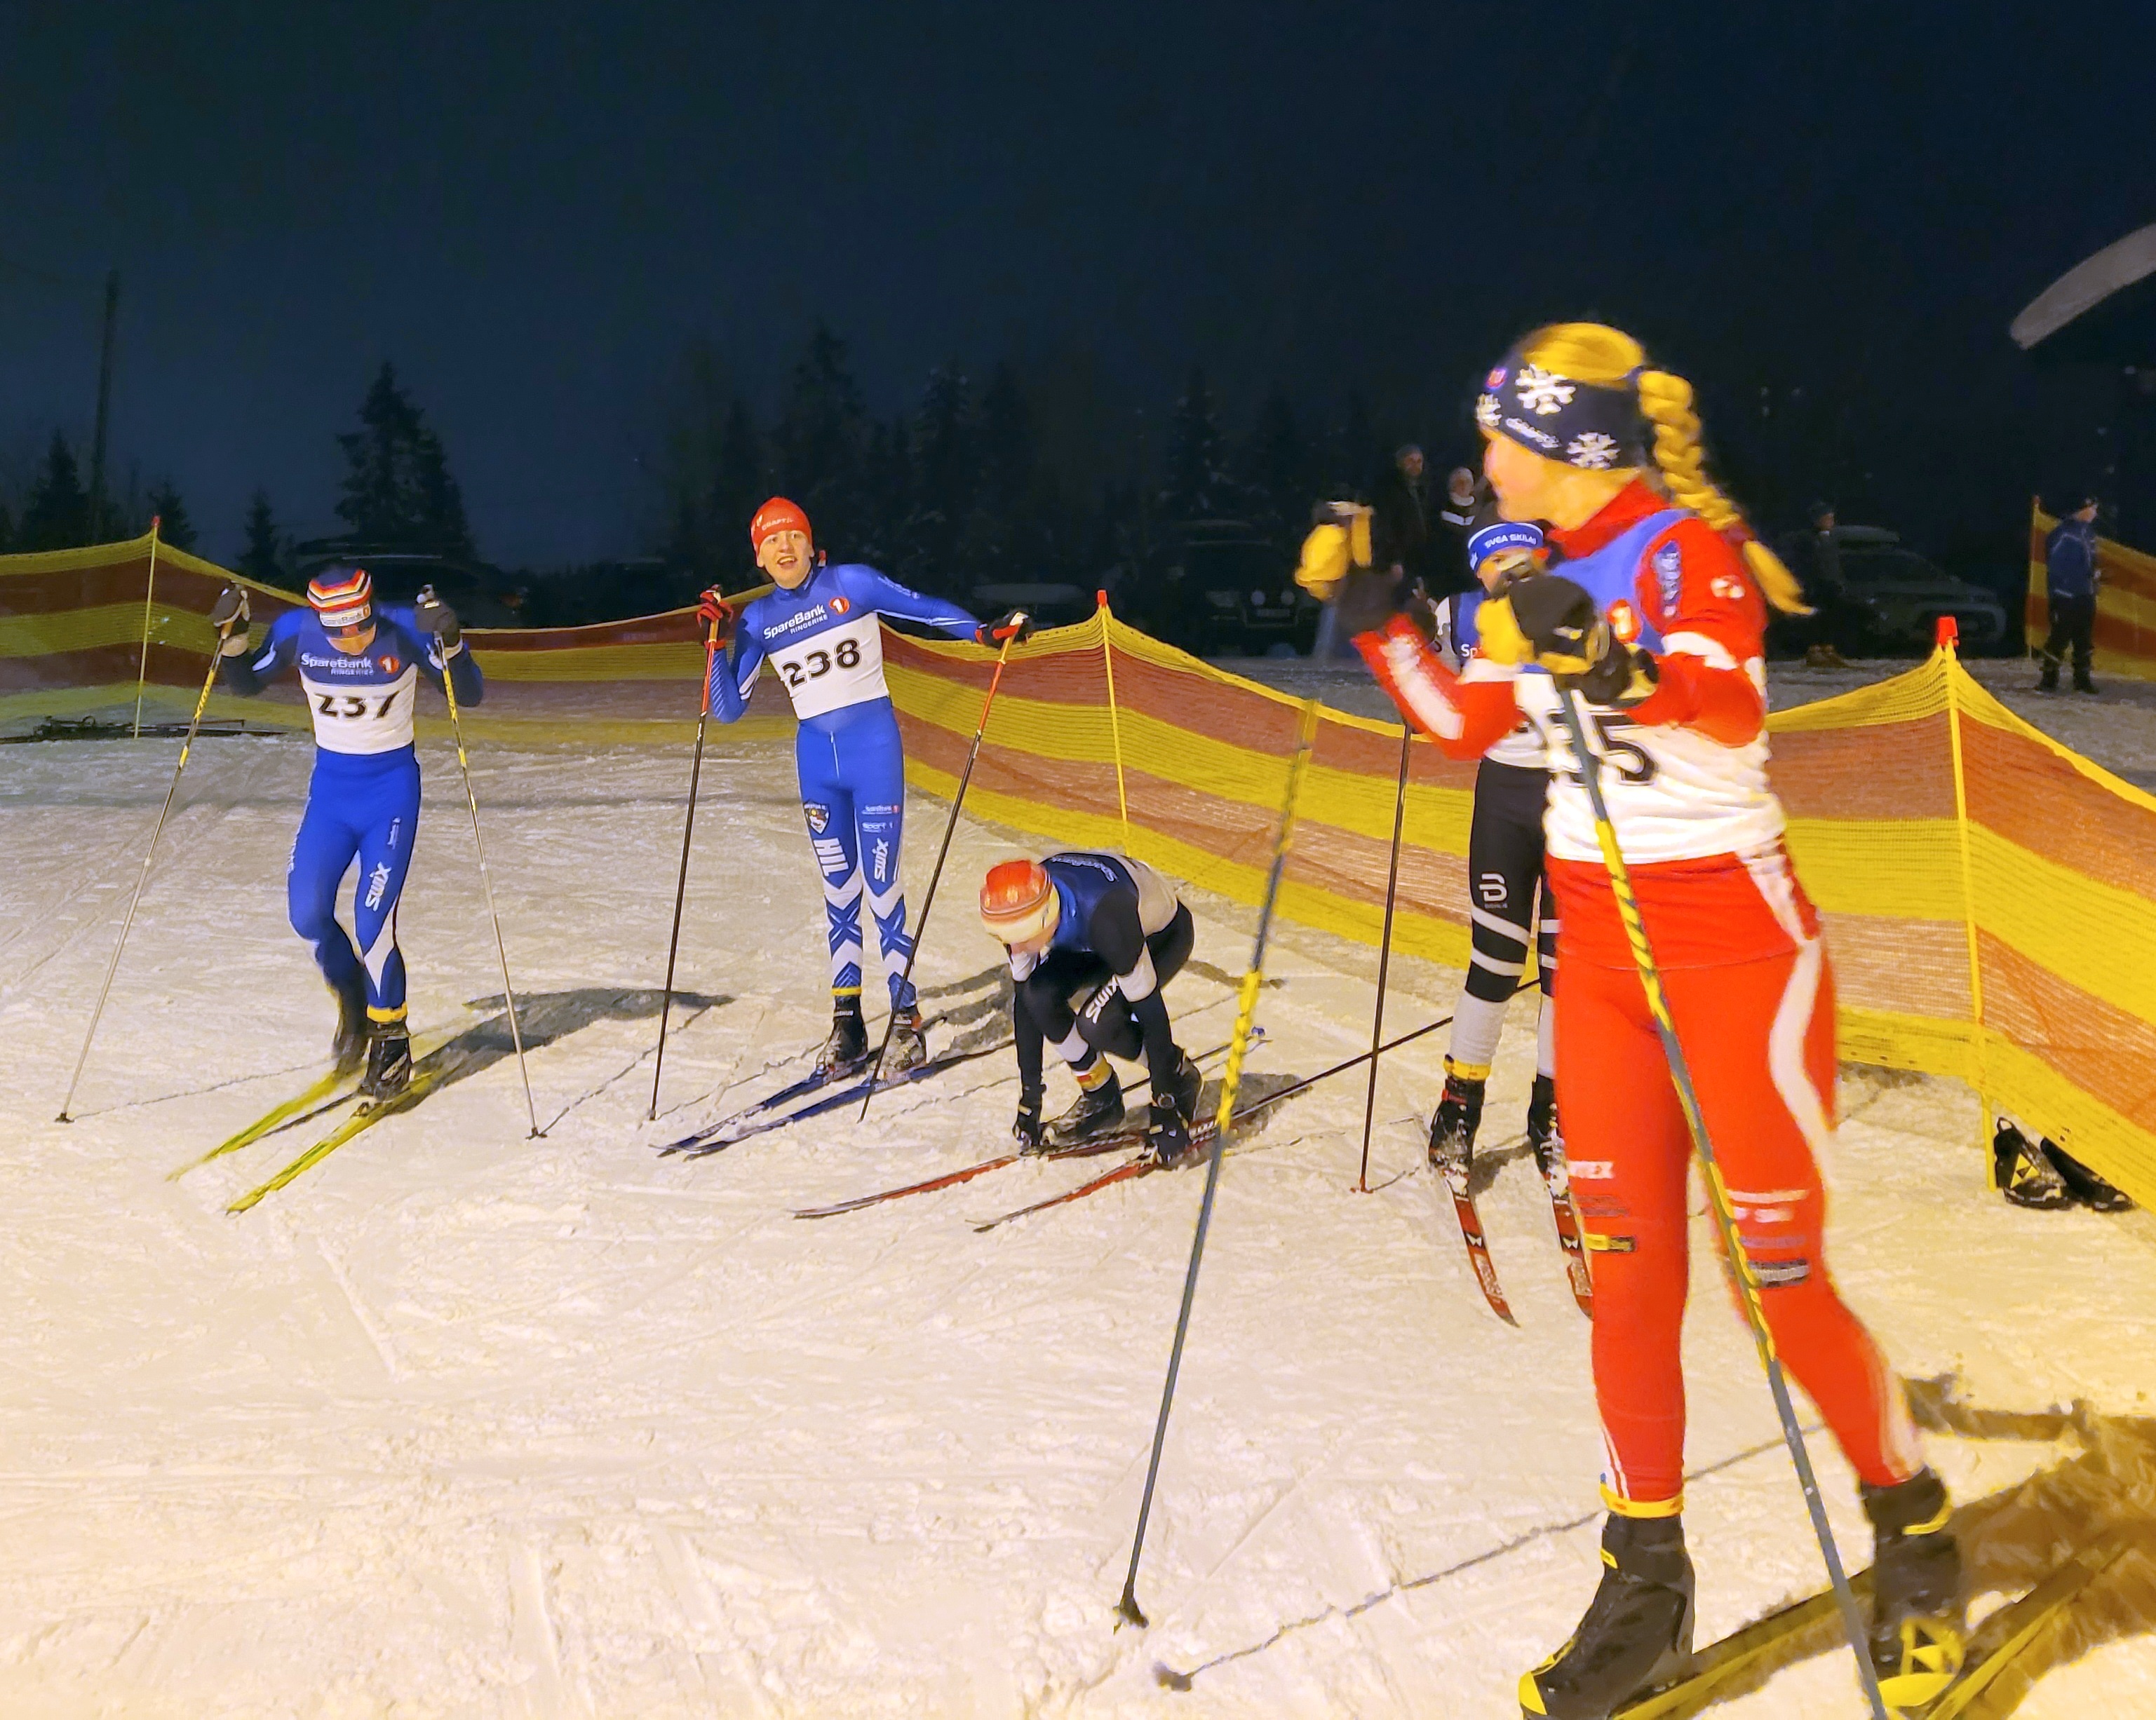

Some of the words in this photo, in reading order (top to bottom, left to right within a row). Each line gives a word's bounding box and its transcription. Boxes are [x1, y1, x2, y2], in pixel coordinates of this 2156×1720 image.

[763, 604, 826, 639] SpareBank
[301, 653, 372, 668] SpareBank
[780, 637, 862, 690] 238
[315, 690, 401, 721] 237
